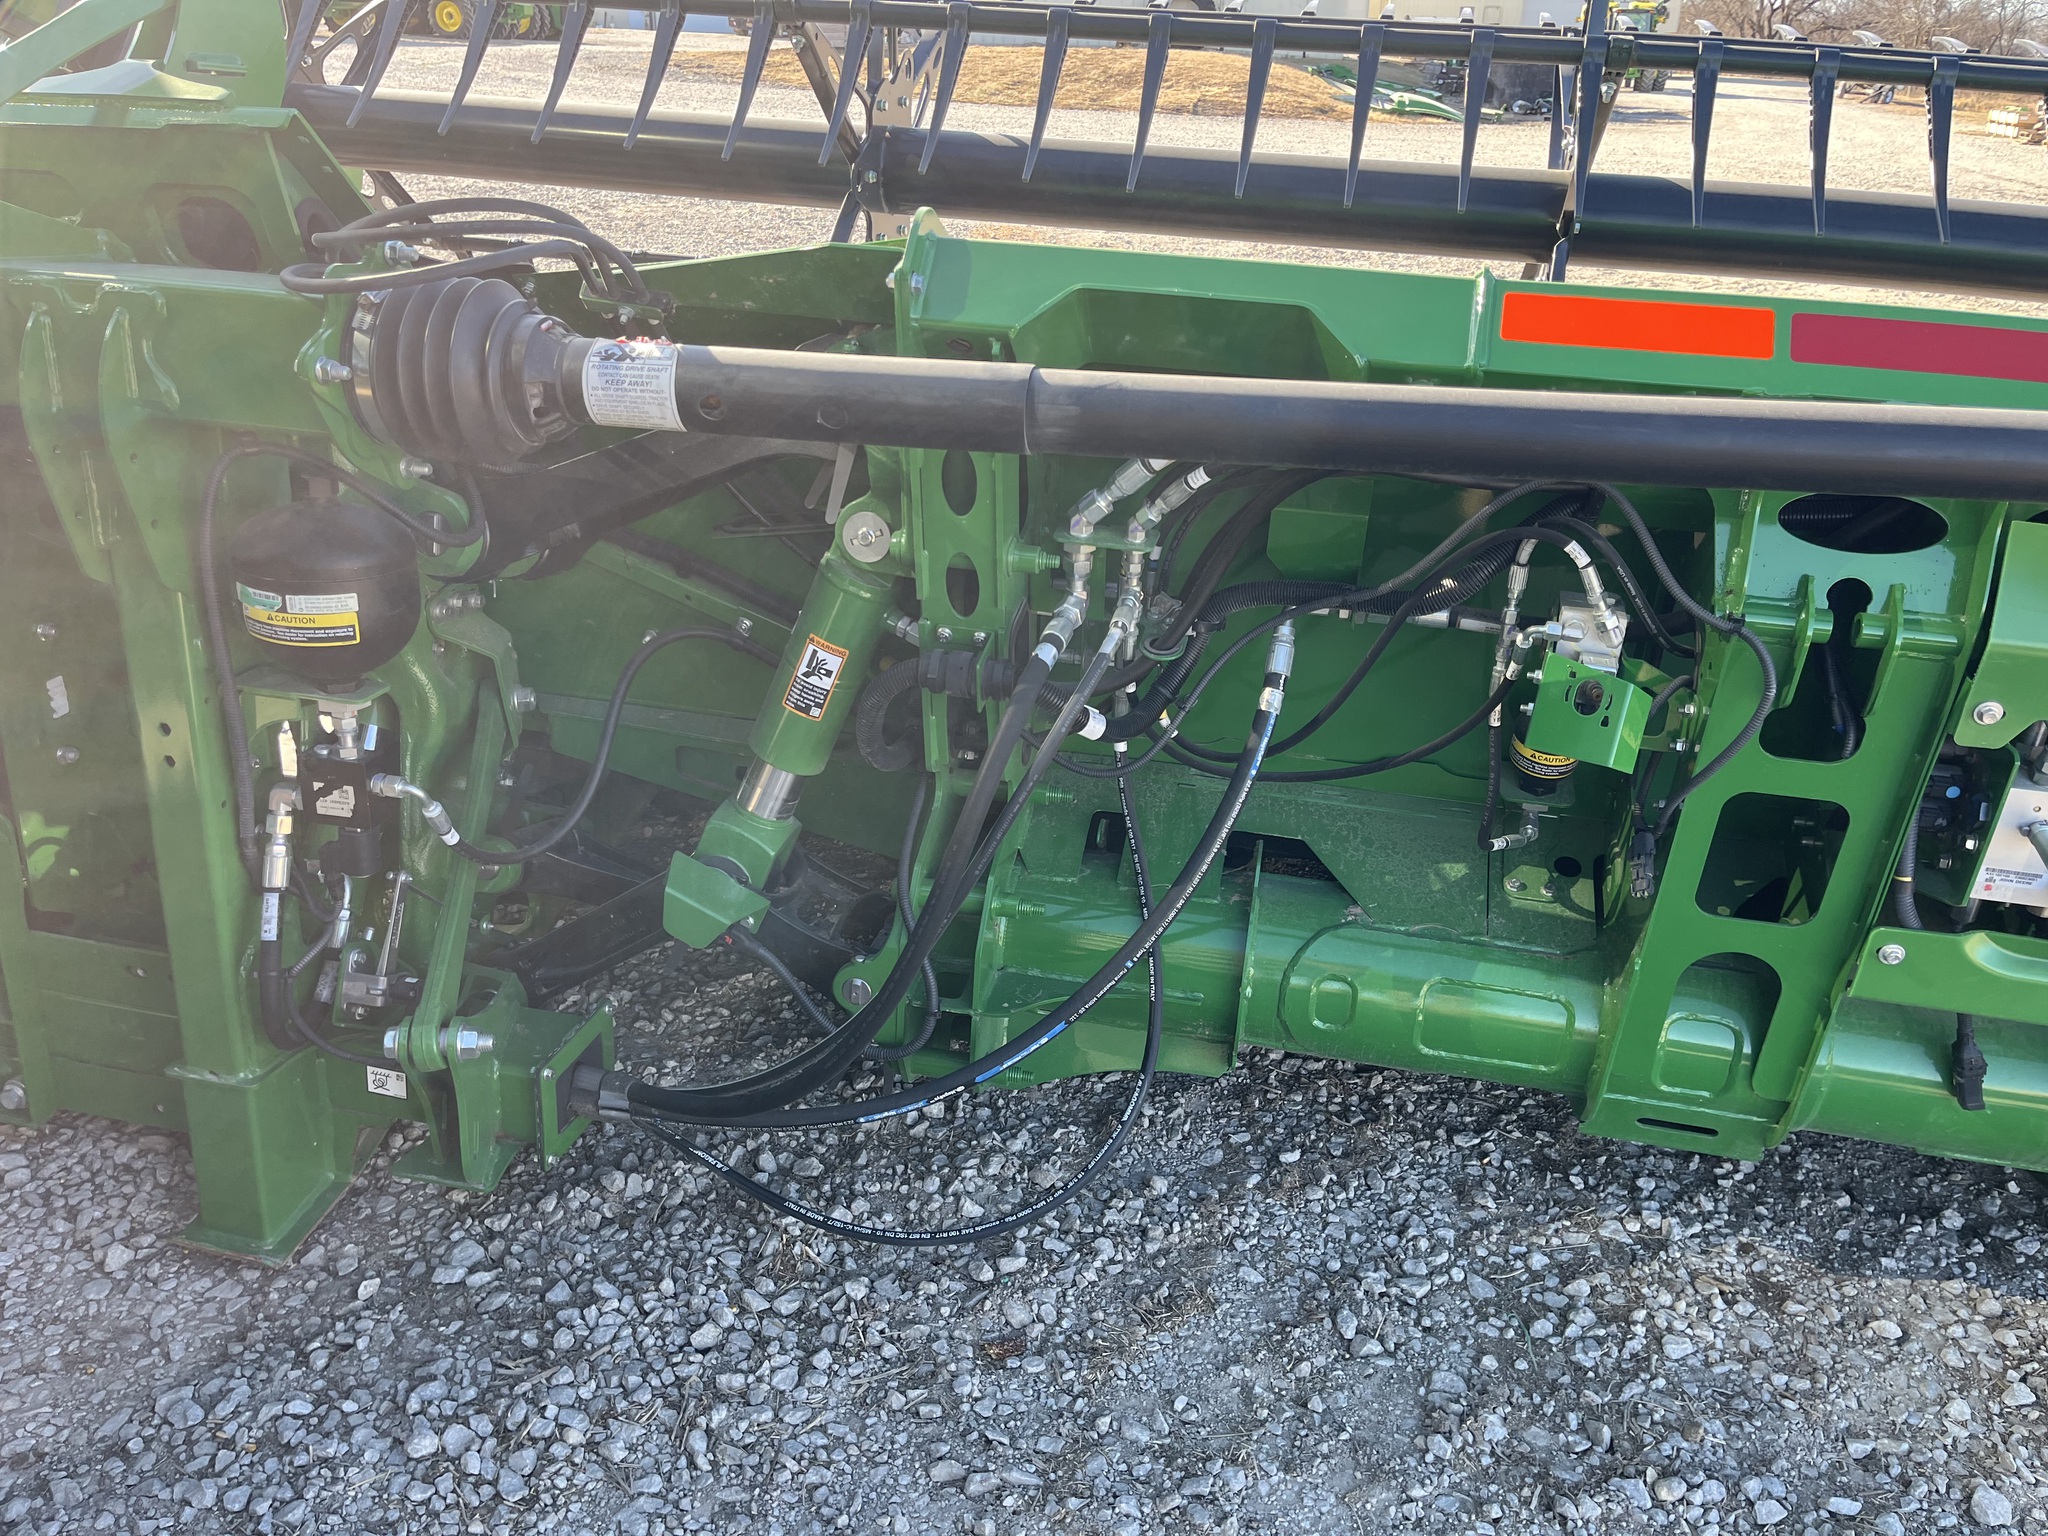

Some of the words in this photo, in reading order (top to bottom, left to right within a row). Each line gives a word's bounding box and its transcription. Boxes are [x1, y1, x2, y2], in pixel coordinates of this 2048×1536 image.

[1617, 566, 1626, 578] USA
[1626, 582, 1636, 596] Made
[275, 614, 315, 624] CAUTION
[816, 639, 846, 656] WARNING
[1538, 755, 1571, 763] CAUTION
[1239, 790, 1247, 802] MPa
[1134, 854, 1139, 862] EN
[1136, 947, 1147, 958] Type
[1114, 968, 1127, 981] Flame
[1150, 975, 1155, 984] IN
[1096, 981, 1116, 998] Resistant
[1086, 997, 1097, 1009] MSHA
[1121, 1079, 1142, 1121] ALFAGOMMA
[1088, 1137, 1113, 1169] SUPERTUFF
[1053, 1189, 1064, 1198] WP
[784, 1201, 799, 1212] ITALY
[1033, 1201, 1046, 1210] MPa
[807, 1210, 824, 1221] MADE
[857, 1226, 872, 1234] MSHA
[975, 1221, 1000, 1231] exceeds
